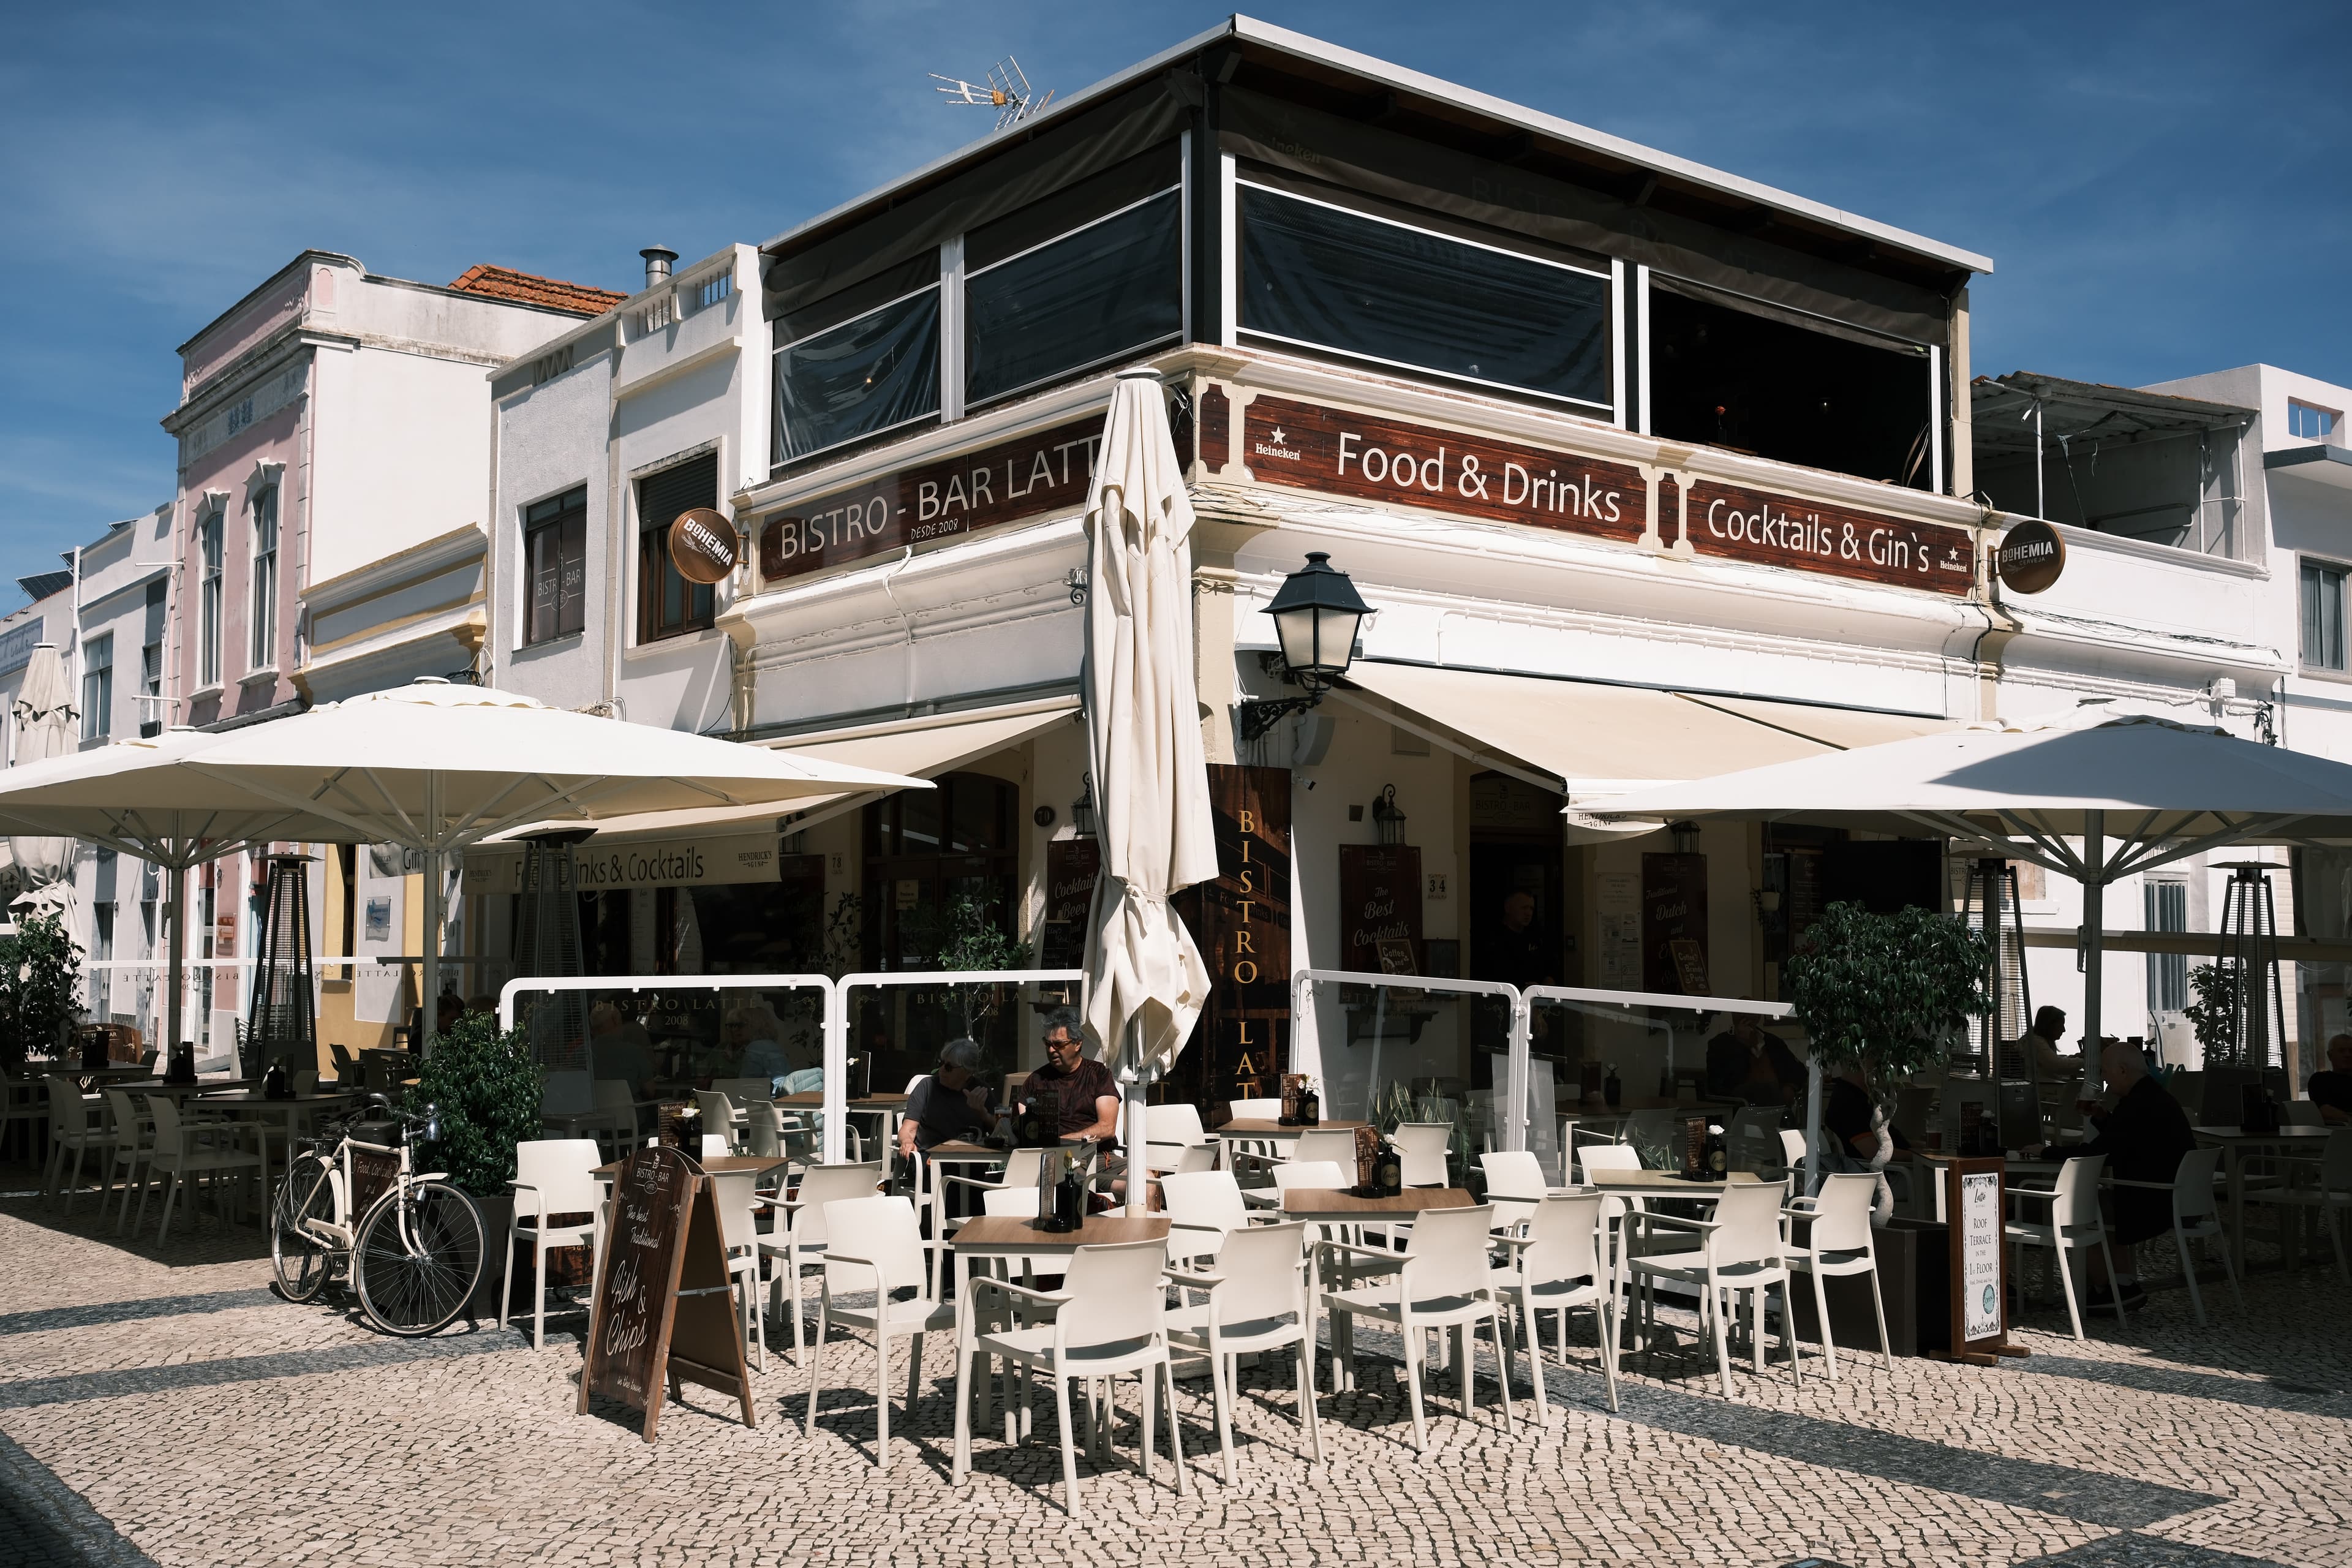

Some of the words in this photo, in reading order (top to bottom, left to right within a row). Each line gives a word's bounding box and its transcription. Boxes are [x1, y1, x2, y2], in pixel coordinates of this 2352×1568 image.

[1255, 443, 1300, 461] Heineken
[1337, 432, 1445, 492] Food
[1458, 454, 1489, 500] &
[1502, 463, 1621, 522] Drinks
[782, 497, 888, 559] BISTRO
[919, 467, 993, 520] BAR
[1008, 433, 1102, 497] LATT
[911, 525, 935, 540] DESDE
[938, 518, 958, 533] 2008
[1708, 499, 1832, 556] Cocktails
[1840, 523, 1861, 561] &
[699, 544, 721, 565] CERVEJA
[2019, 557, 2046, 566] CERVEJA
[1939, 560, 1968, 573] Heineken
[538, 578, 557, 597] BISTR
[566, 568, 582, 586] BAR
[559, 854, 606, 884] Dinks
[610, 854, 623, 882] &
[628, 846, 703, 881] Cocktails
[739, 850, 772, 861] HENDRICK'S
[832, 858, 842, 868] 78
[1234, 810, 1258, 984] BISTRO
[1374, 887, 1389, 897] The
[1063, 902, 1087, 919] Beer
[1364, 899, 1394, 919] Best
[1656, 900, 1687, 921] Dutch
[1354, 921, 1409, 947] Cocktails
[1671, 922, 1683, 935] and
[1382, 947, 1404, 957] Coffee
[595, 999, 678, 1011] BISTRO
[665, 1016, 688, 1025] 2008
[1235, 1021, 1256, 1100] LAT
[636, 1167, 655, 1180] BISTRO
[658, 1172, 669, 1183] BAR
[627, 1204, 636, 1220] The
[636, 1206, 649, 1223] best
[1973, 1218, 1987, 1229] ROOF
[630, 1226, 662, 1250] Traditional
[1970, 1234, 1991, 1246] TERRACE
[1977, 1262, 1993, 1274] FLOOR
[611, 1253, 640, 1308] Fish
[638, 1285, 646, 1314] &
[606, 1310, 647, 1367] Chips
[617, 1376, 623, 1385] in
[622, 1376, 631, 1389] the
[630, 1379, 641, 1392] town
